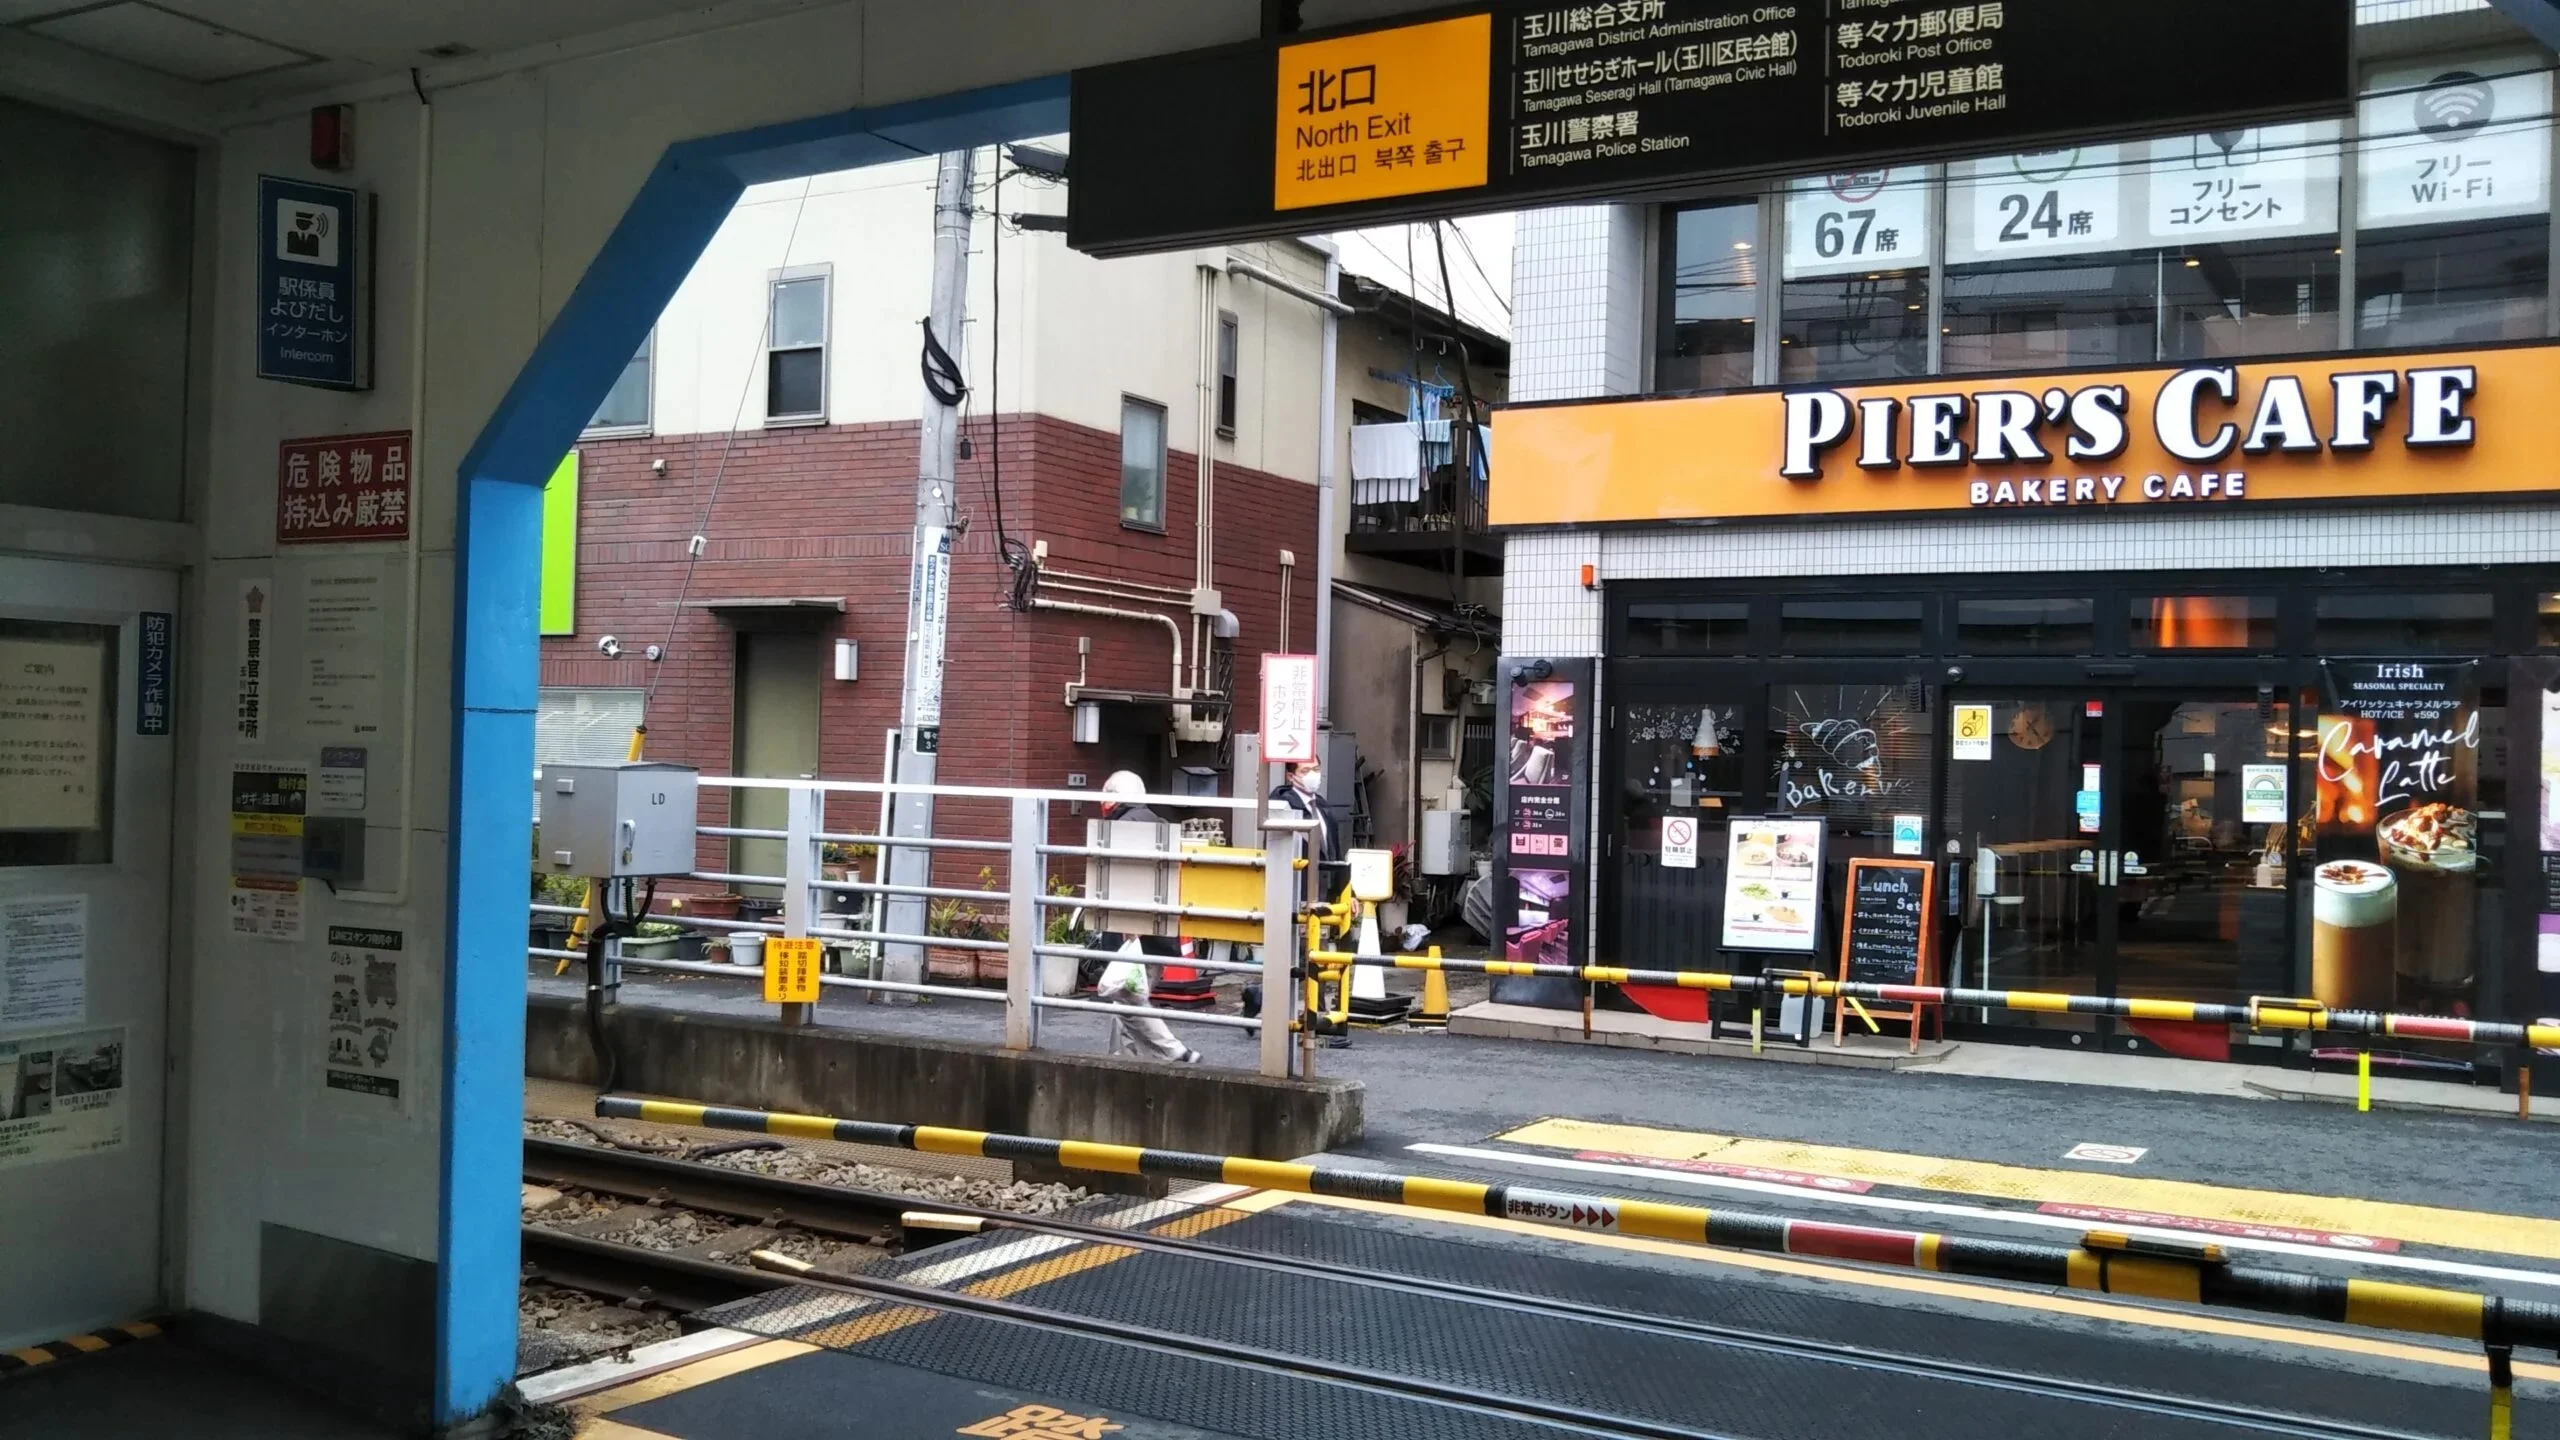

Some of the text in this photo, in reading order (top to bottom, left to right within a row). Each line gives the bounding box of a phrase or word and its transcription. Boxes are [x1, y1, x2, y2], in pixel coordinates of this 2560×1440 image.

[1522, 0, 1665, 39] 玉川総合支所
[1523, 6, 1795, 57] Tamagawa District Administration Office
[1837, 3, 2004, 49] 等々力郵便局
[1837, 36, 1992, 68] Todoroki Post Office
[1297, 63, 1377, 115] 北口
[1523, 60, 1797, 112] Tamagawa Seseragi Hall (Tamagawa Civic Hall)
[1837, 63, 2004, 108] 等々力児童館
[1836, 94, 2006, 128] Todoroki Juvenile Hall
[1296, 112, 1412, 150] North Exit
[1520, 111, 1639, 149] 玉川警察署
[1374, 138, 1466, 170] 북쪽 출구
[1520, 135, 1690, 168] Tamagawa Police Station
[1296, 154, 1357, 182] 北出口
[2416, 155, 2492, 181] フリー
[2192, 176, 2262, 201] フリー
[2411, 177, 2494, 203] Wi-Fi
[2170, 198, 2283, 226] コンセント
[278, 277, 336, 302] 駅係員
[270, 299, 343, 324] よびだし
[266, 323, 347, 344] インターホン
[279, 347, 334, 363] Intercom
[1781, 364, 2476, 479] PIER'S CAFE
[287, 445, 406, 488] 危険物品
[1970, 471, 2246, 506] BAKERY CAFE
[283, 489, 405, 532] 持込み厳禁
[144, 616, 165, 732] 防犯カメラ作動中
[2353, 682, 2445, 692] SEASONAL SPECIALTY
[2377, 663, 2424, 679] Irish
[1291, 665, 1308, 731] 非常停止
[2340, 699, 2462, 710] アイリッシュキャラメルラテ
[2360, 709, 2440, 719] HOT/ICE ¥590
[2318, 711, 2480, 782] Caramel
[2375, 750, 2456, 807] Latte
[651, 792, 665, 805] LD
[1858, 869, 1909, 893] Lunch
[1896, 897, 1921, 912] Set
[1508, 1199, 1571, 1220] 非常ボタン
